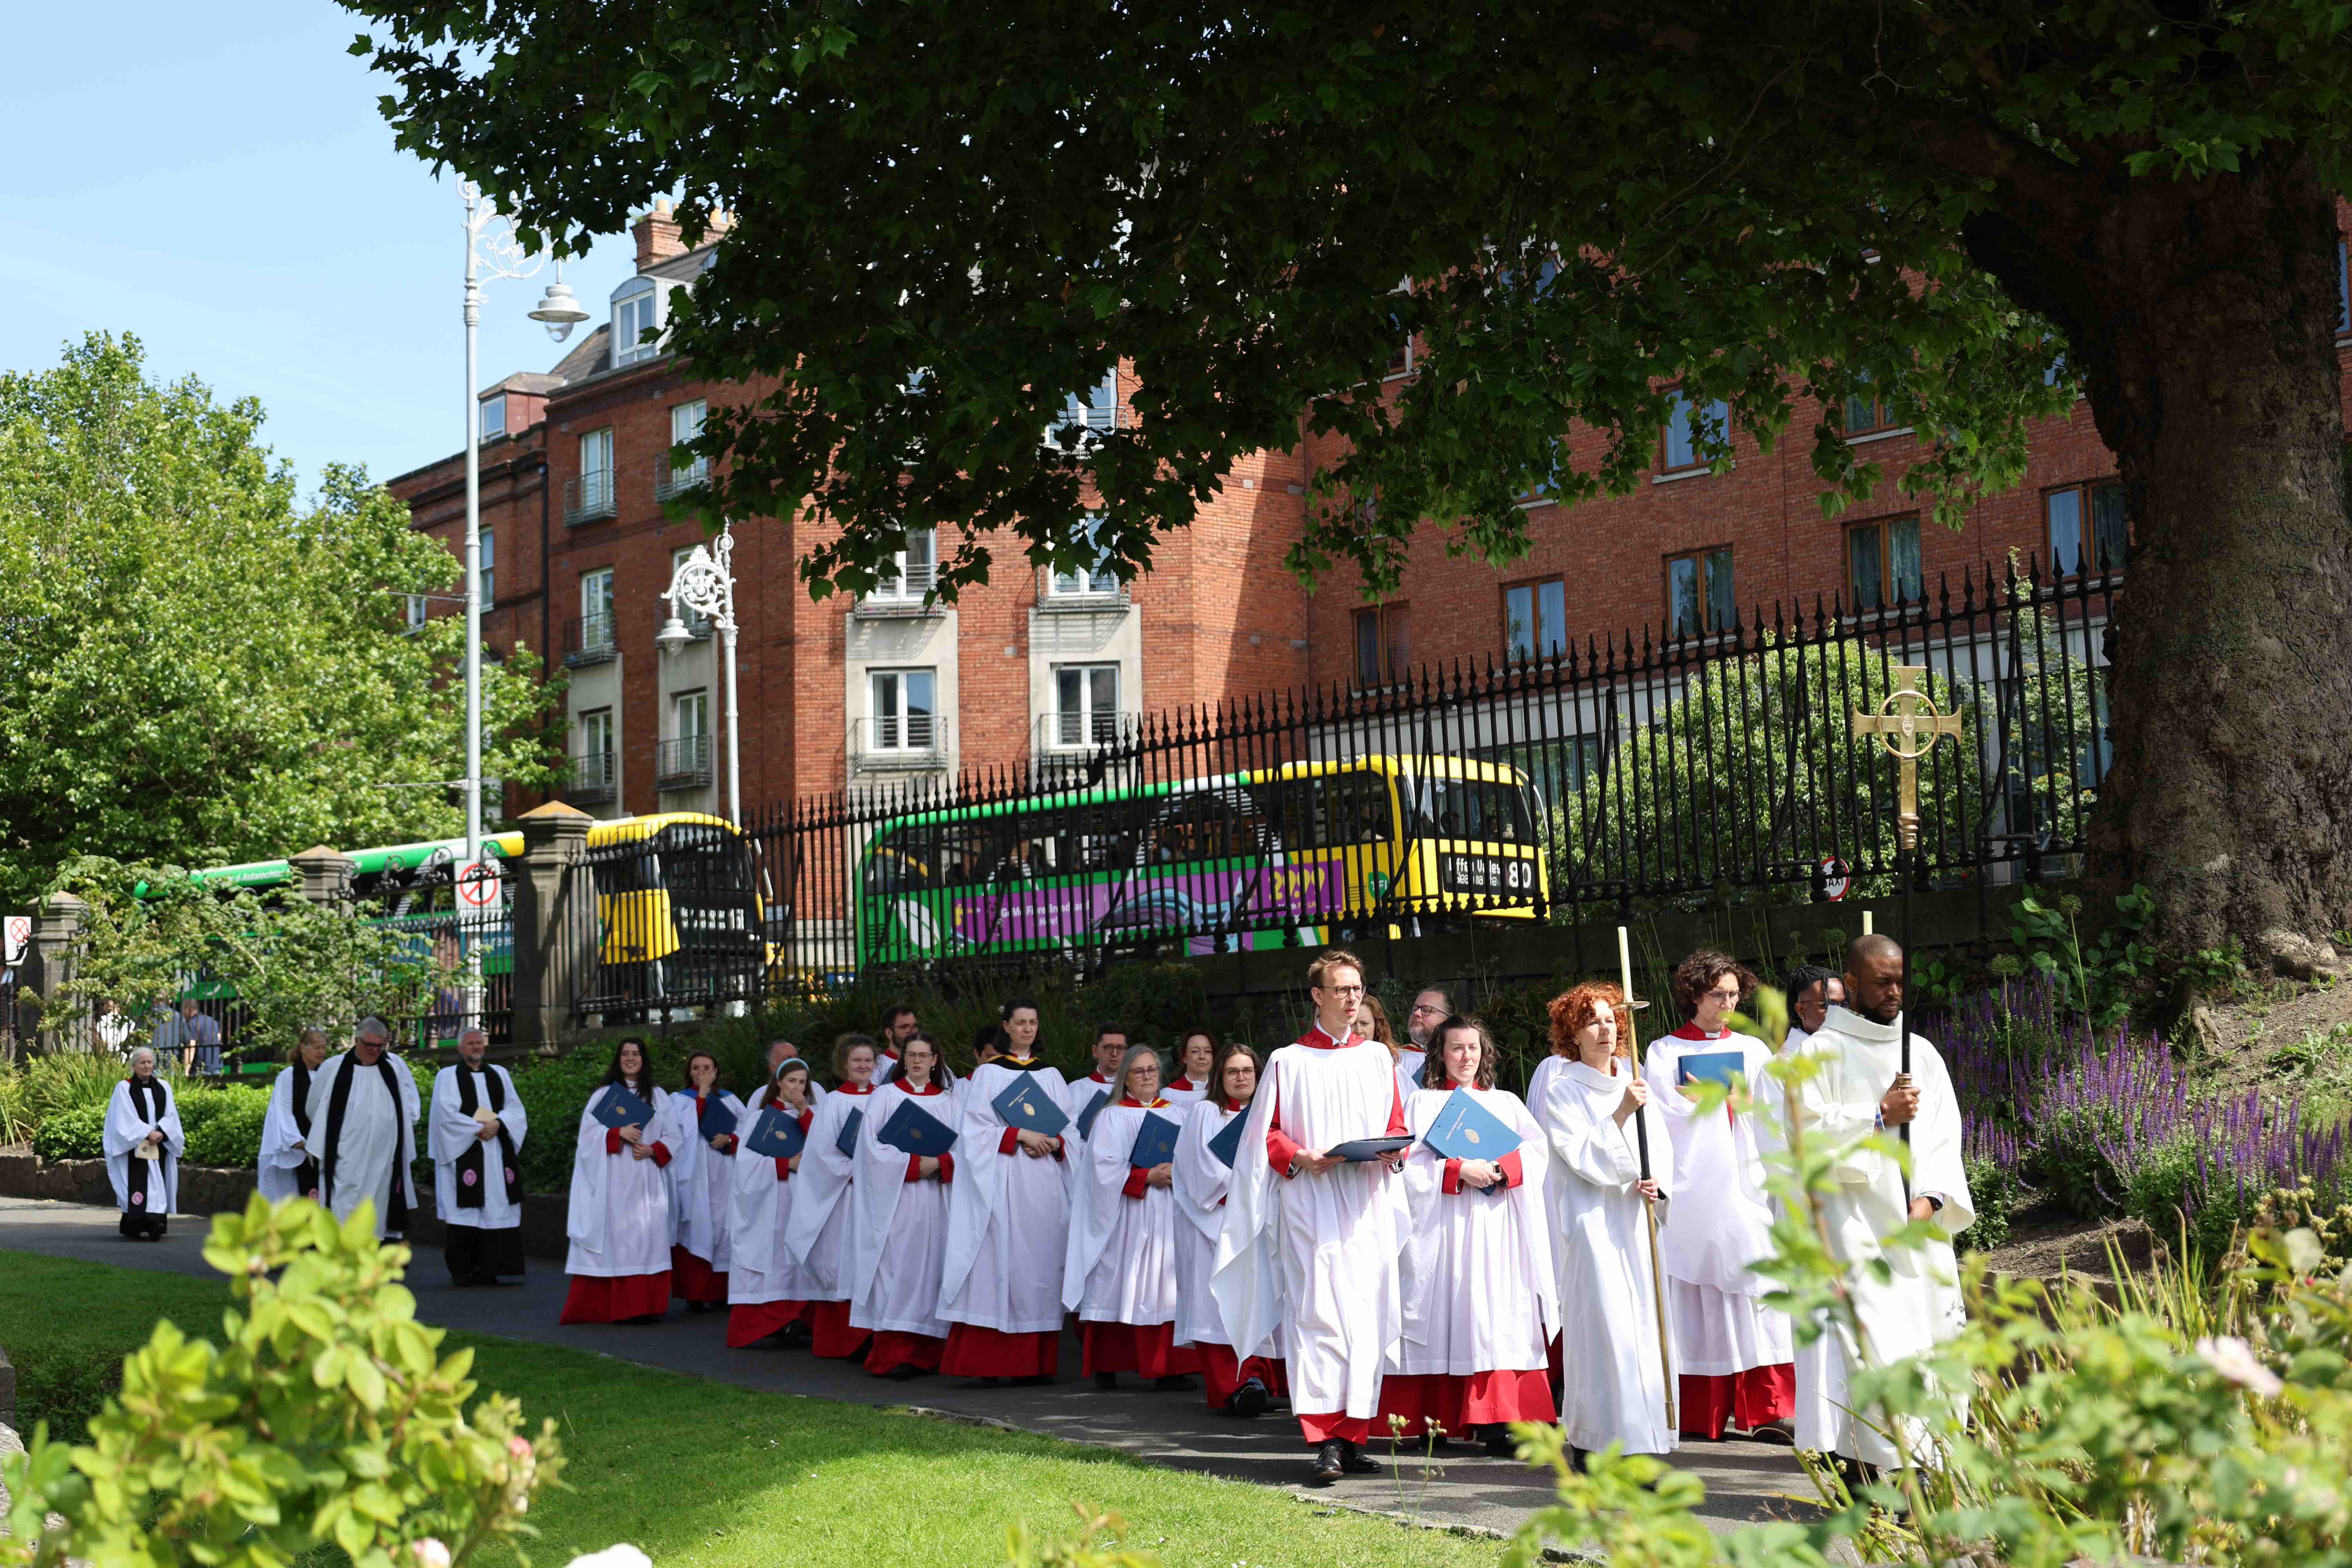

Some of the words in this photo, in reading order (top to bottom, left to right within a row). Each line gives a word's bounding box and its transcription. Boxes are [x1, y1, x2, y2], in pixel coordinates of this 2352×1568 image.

[1509, 862, 1532, 888] 80
[1828, 877, 1844, 887] AXI
[1026, 905, 1046, 915] Fire
